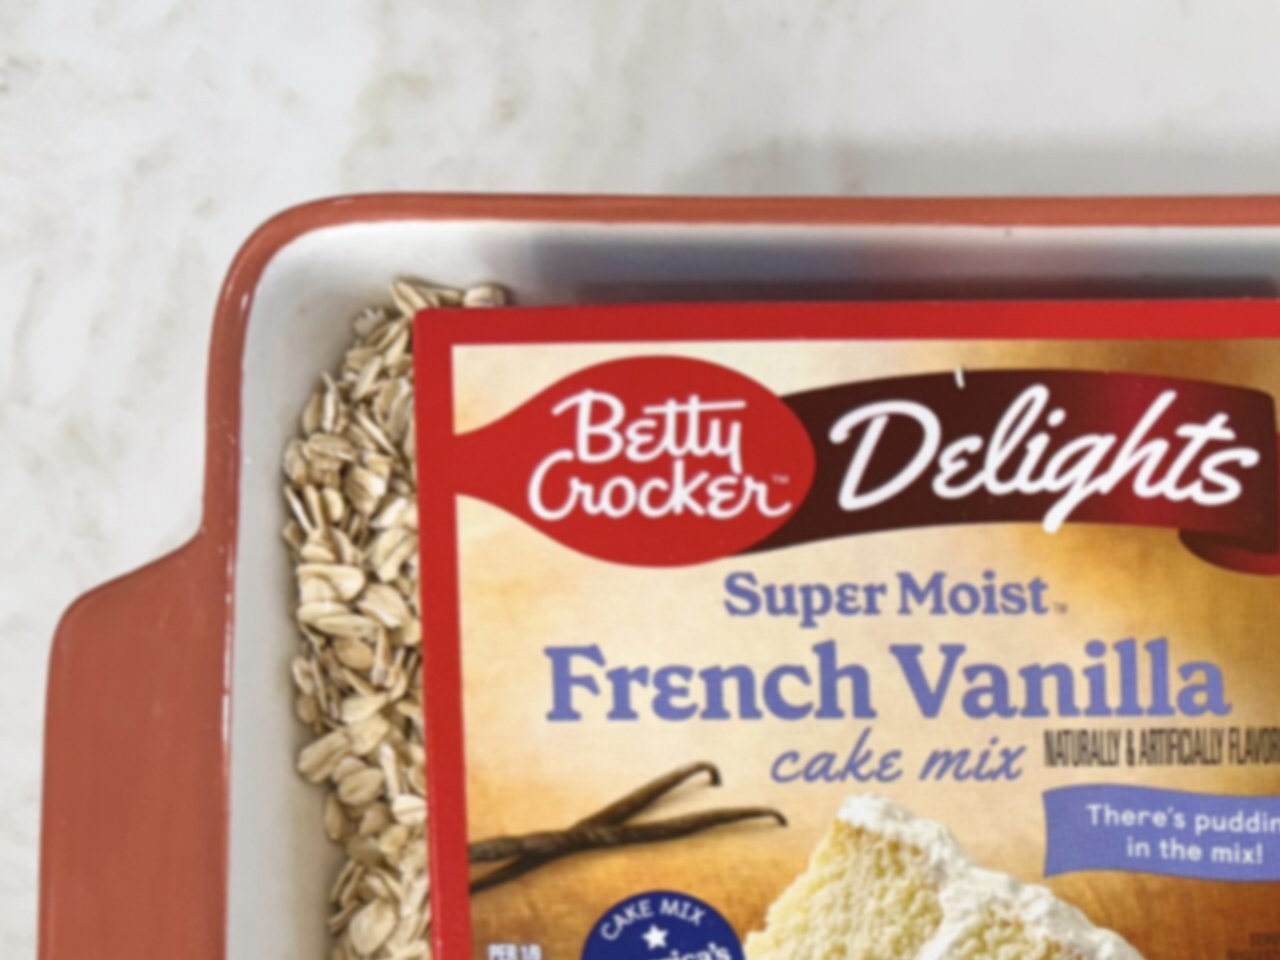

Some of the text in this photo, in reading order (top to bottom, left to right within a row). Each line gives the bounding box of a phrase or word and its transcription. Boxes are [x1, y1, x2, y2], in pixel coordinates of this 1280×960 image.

[552, 389, 746, 474] Betty
[829, 384, 1261, 534] Delights
[528, 450, 792, 521] Crocker
[723, 570, 887, 629] Super
[896, 569, 1050, 616] Moist
[543, 637, 1233, 721] French Vanilla
[770, 727, 1028, 784] cake mix
[1043, 728, 1122, 767] NATURALLY
[1138, 727, 1225, 766] ARTIFICIALLY
[1086, 803, 1186, 828] There's
[1126, 836, 1264, 865] in the mix!
[600, 898, 706, 941] CAKE MIX
